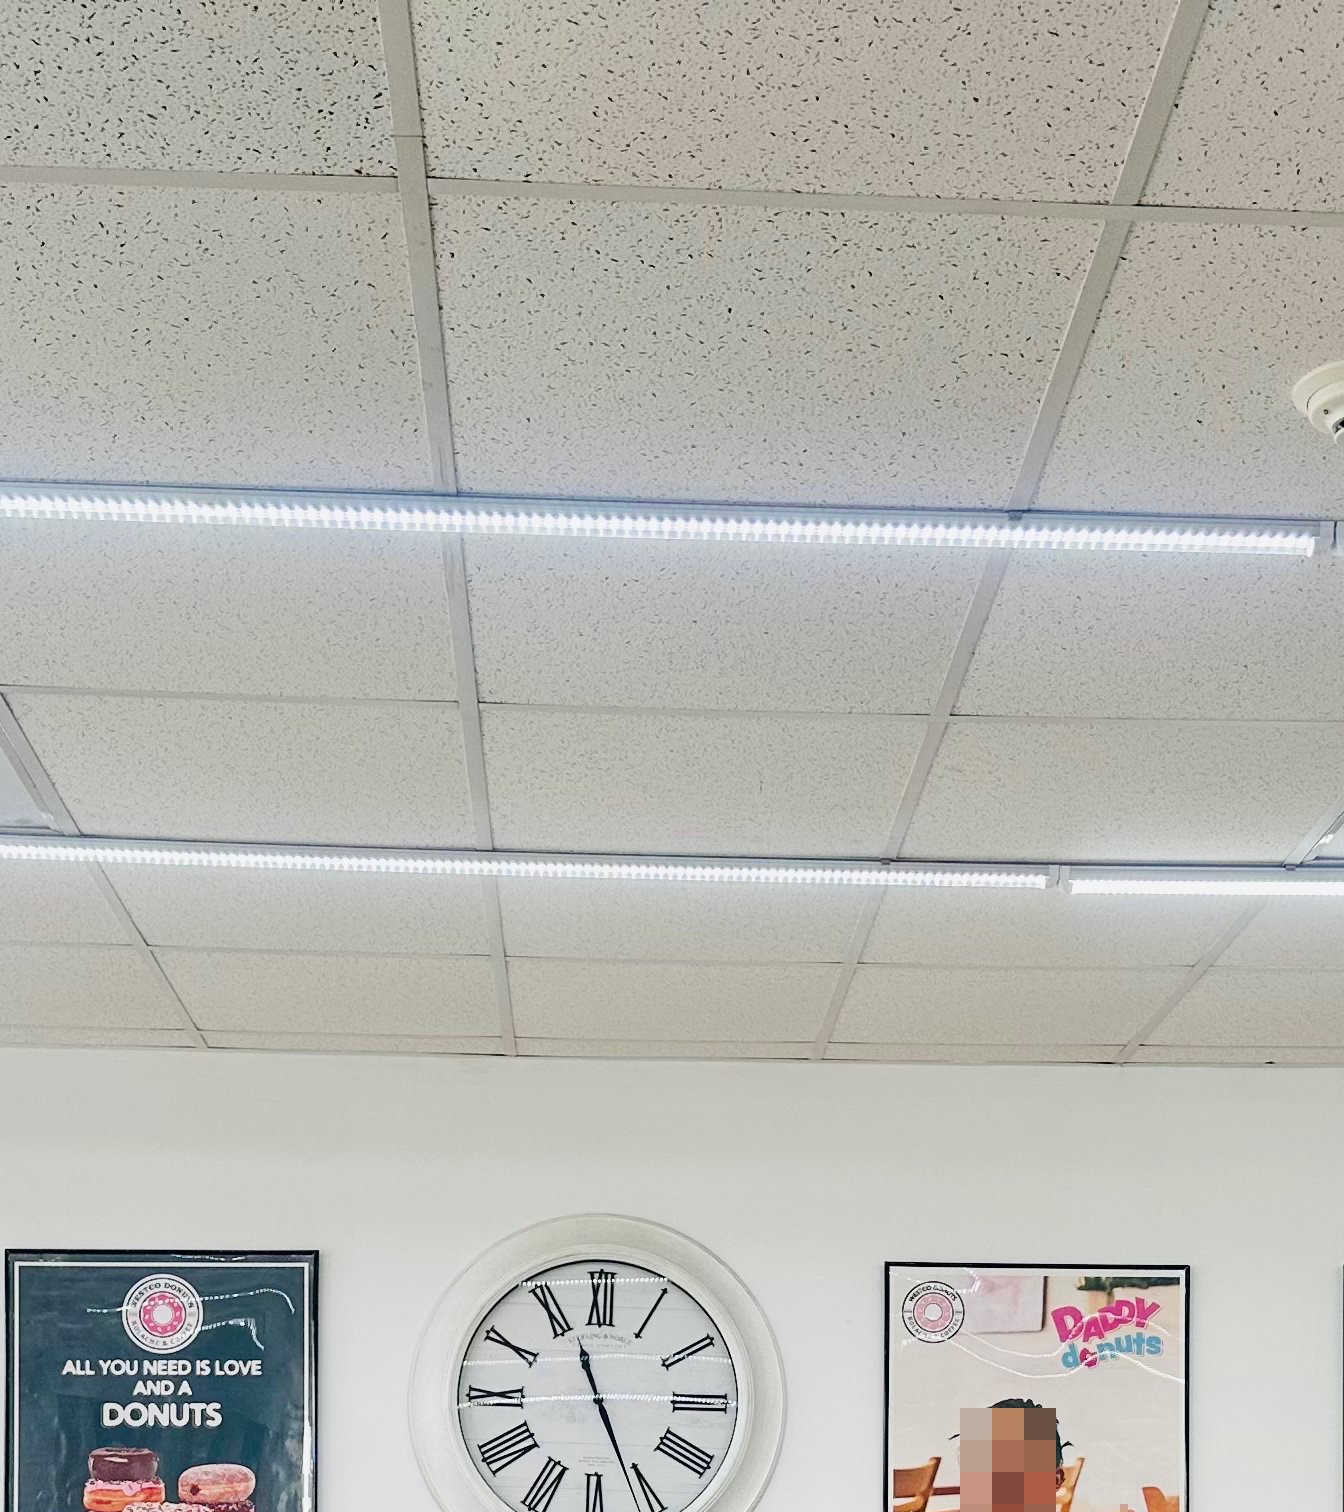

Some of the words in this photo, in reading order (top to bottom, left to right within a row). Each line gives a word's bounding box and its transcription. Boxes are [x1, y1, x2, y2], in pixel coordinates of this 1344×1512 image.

[586, 1269, 617, 1327] XII
[1051, 1297, 1160, 1342] DADDY
[1061, 1332, 1162, 1369] donuts
[61, 1359, 96, 1376] ALL
[99, 1359, 139, 1376] YOU
[143, 1359, 192, 1376] NEED
[196, 1359, 211, 1376] IS
[215, 1359, 263, 1376] LOVE
[132, 1380, 175, 1396] AND
[177, 1380, 193, 1396] A
[101, 1401, 223, 1428] DONUTS
